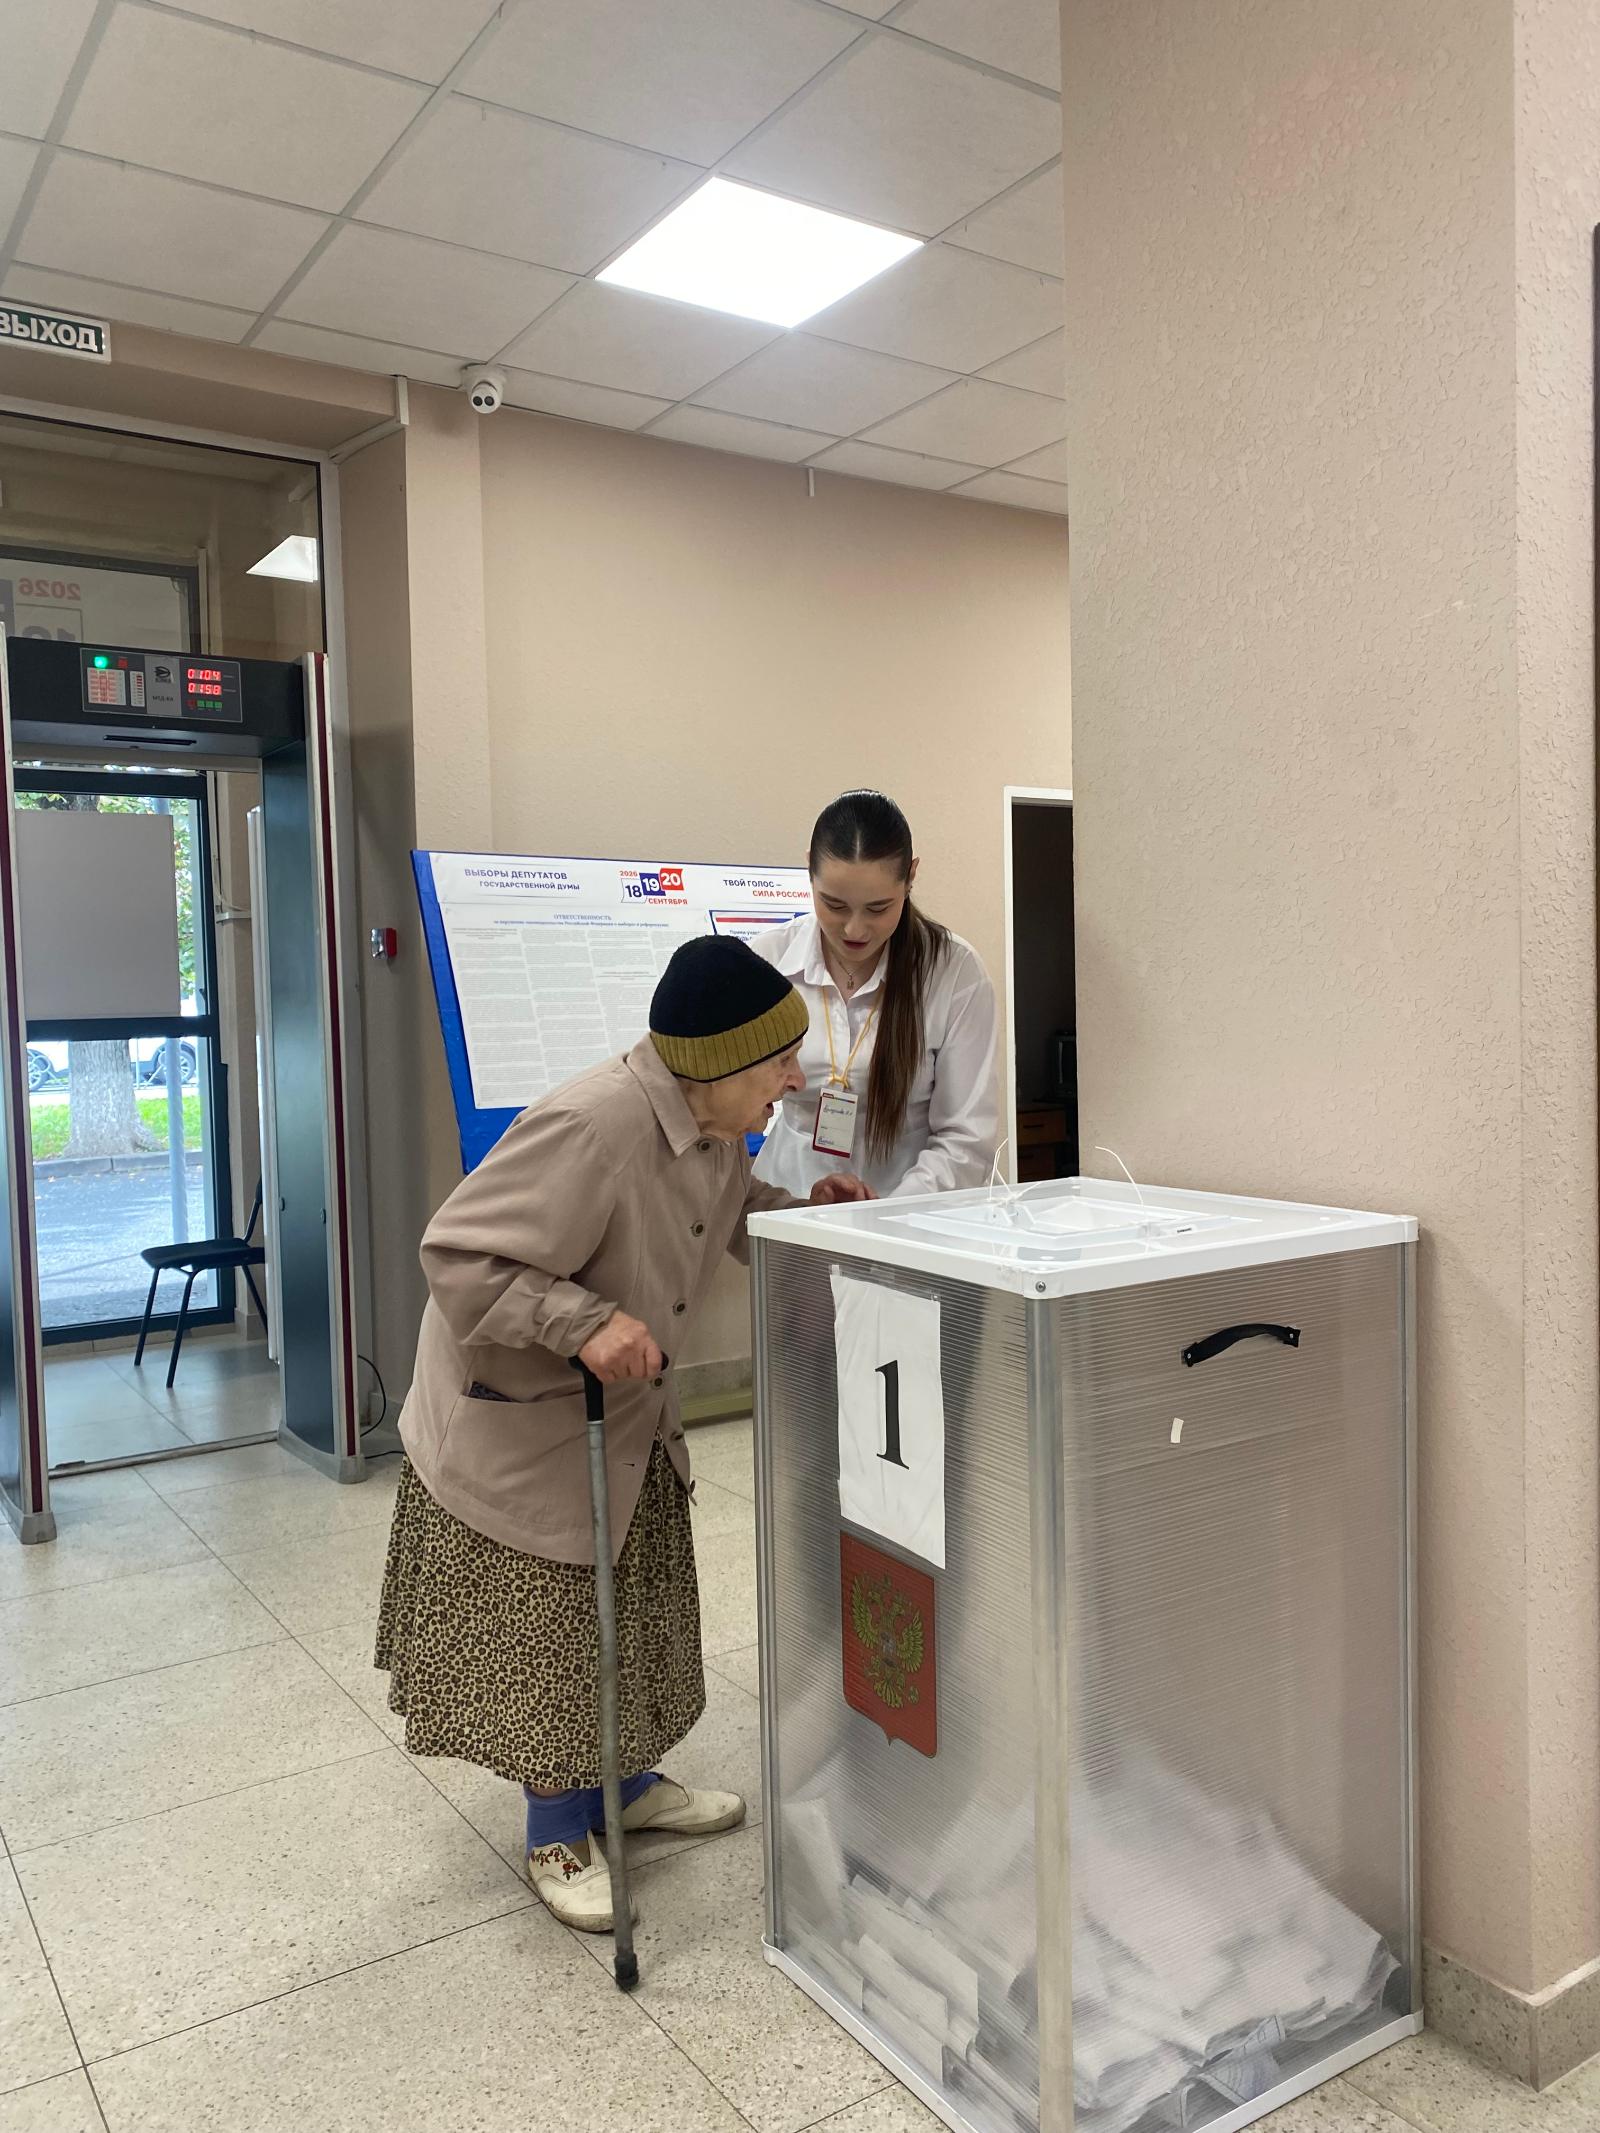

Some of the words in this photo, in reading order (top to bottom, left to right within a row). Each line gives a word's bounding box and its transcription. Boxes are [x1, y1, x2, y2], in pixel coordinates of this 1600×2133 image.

[0, 312, 98, 352] ВЫХОД
[464, 868, 510, 878] ВЫБОРЫ
[511, 870, 568, 881] ДЕПУТАТОВ
[479, 880, 556, 890] ГОСУДАРСТВЕННОЙ
[557, 883, 580, 891] ДУМЫ
[625, 885, 642, 898] 18
[642, 877, 660, 892] 19
[660, 872, 681, 887] 20
[723, 878, 746, 887] ТВОЙ
[747, 880, 775, 888] ГОЛОС
[752, 890, 775, 898] СИЛА
[874, 1359, 910, 1470] 1
